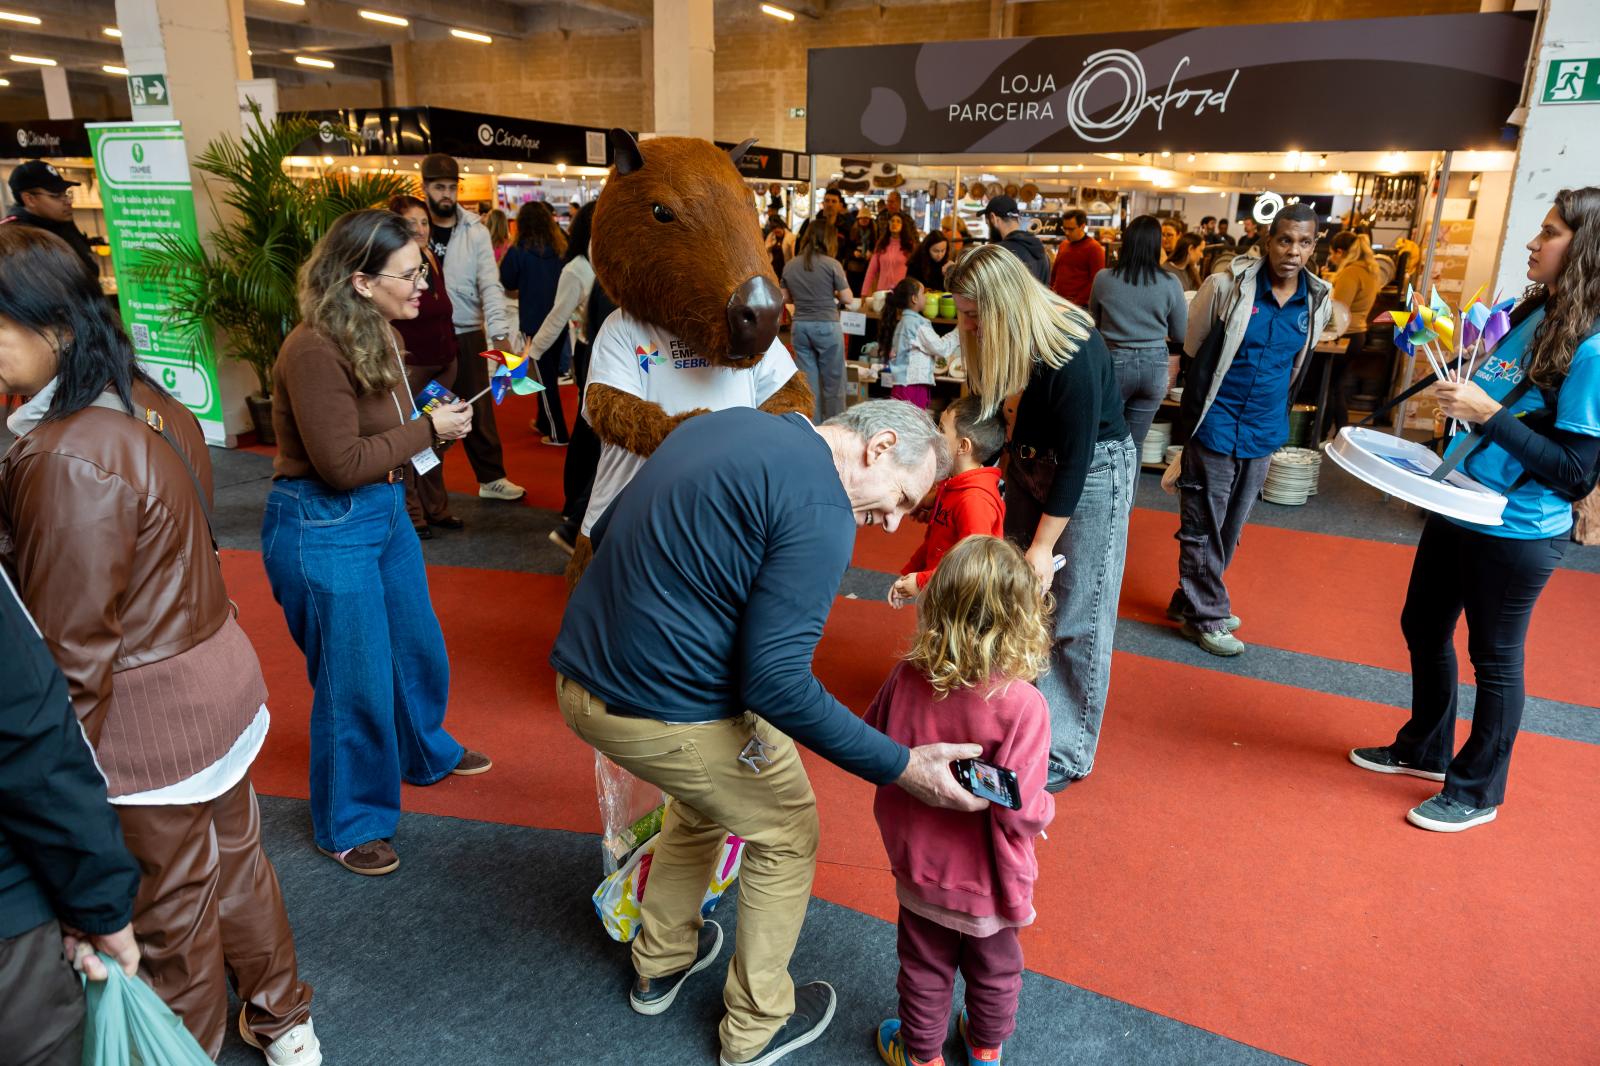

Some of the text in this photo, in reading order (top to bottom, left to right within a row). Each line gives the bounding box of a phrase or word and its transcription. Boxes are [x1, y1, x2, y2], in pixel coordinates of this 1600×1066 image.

[1001, 74, 1056, 94] LOJA
[1067, 49, 1240, 143] Oxford
[949, 102, 1055, 122] PARCEIRA
